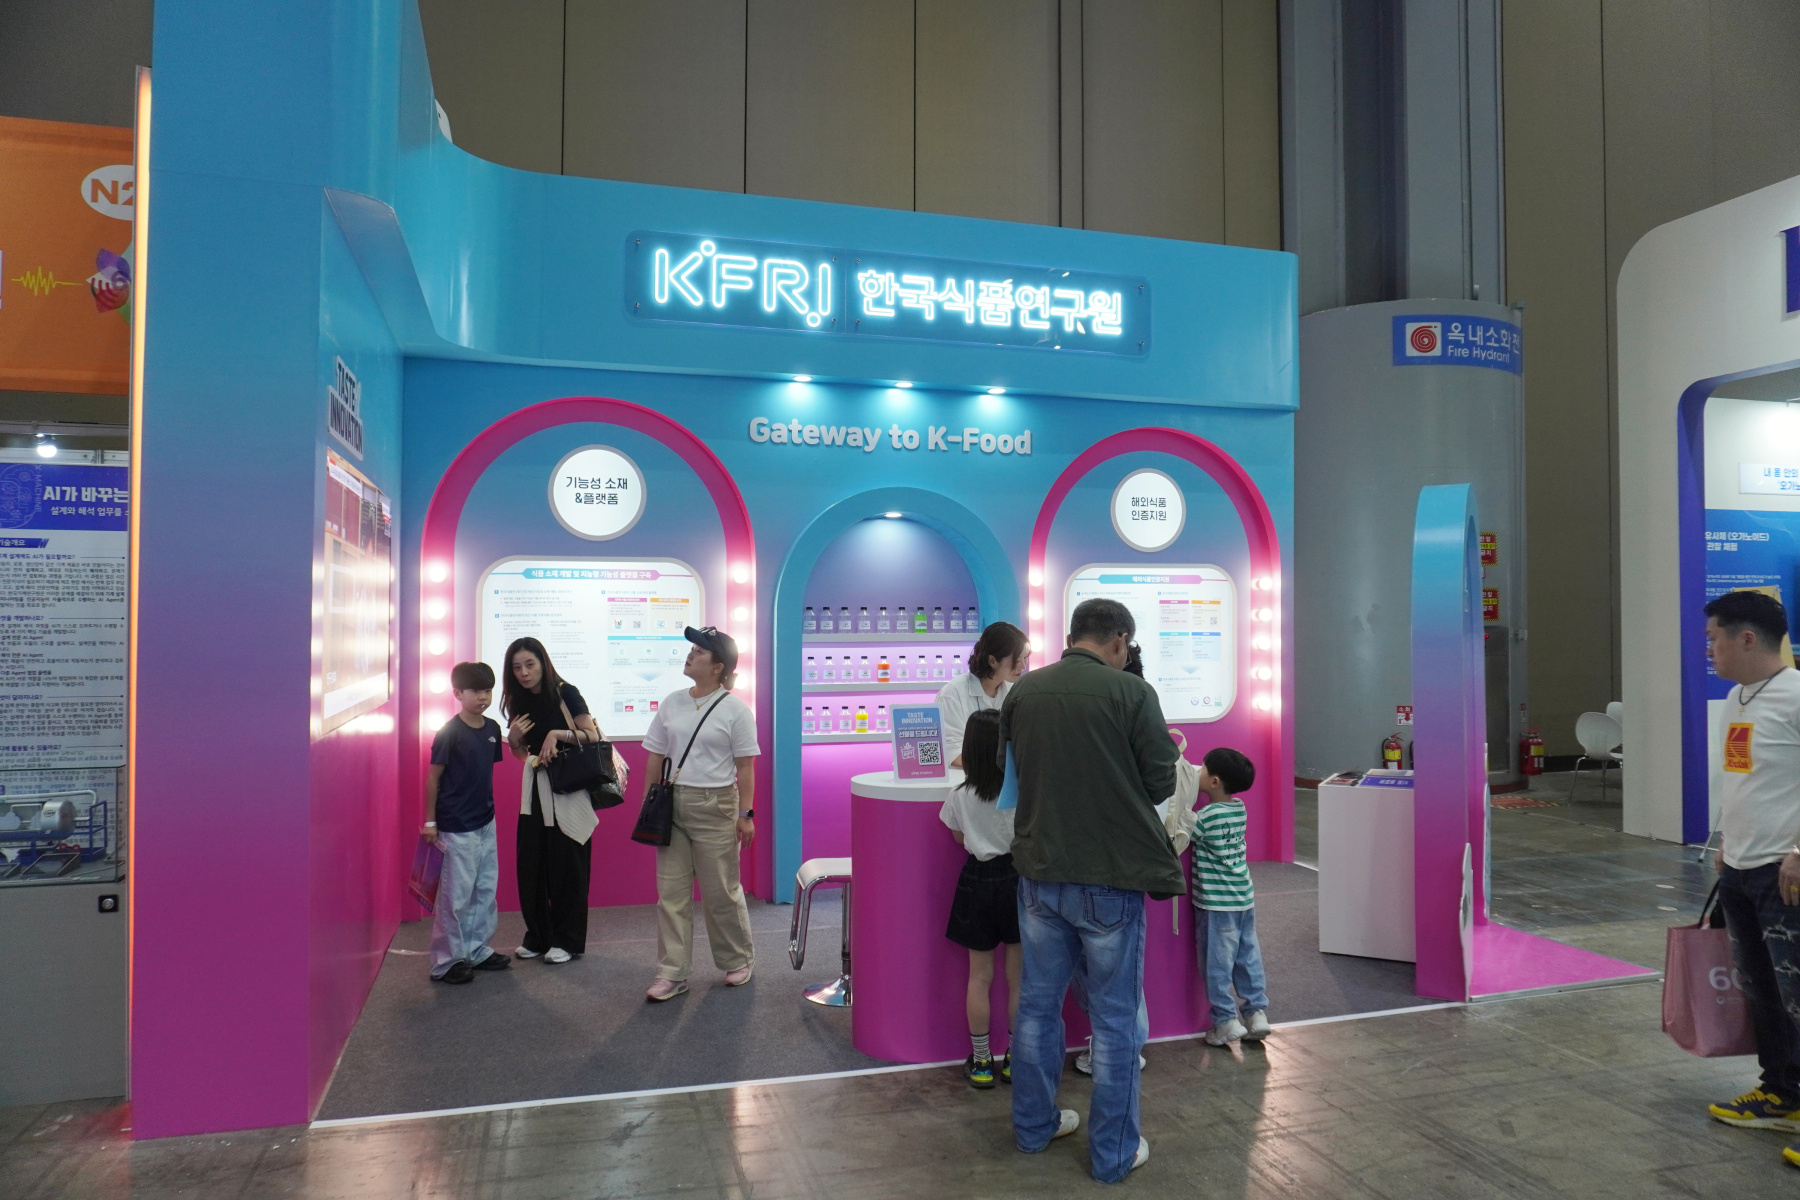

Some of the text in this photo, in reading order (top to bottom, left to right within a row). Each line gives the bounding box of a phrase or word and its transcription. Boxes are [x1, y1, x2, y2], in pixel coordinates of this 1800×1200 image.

[653, 239, 832, 328] KFRI
[857, 269, 1123, 336] 한국식품연구원
[1447, 322, 1520, 354] 옥내소화전
[1448, 345, 1510, 363] Fire Hydrant
[337, 361, 356, 413] TASTE
[330, 391, 363, 456] INNOVATION
[749, 416, 1032, 456] Gateway to K-Food
[566, 476, 628, 490] 기능성 소재
[43, 486, 128, 503] AI가 바꾸는
[575, 492, 619, 505] &플랫폼
[1131, 496, 1167, 508] 해외식품
[50, 506, 122, 517] 설계와 해석 업무를
[1131, 510, 1167, 521] 인증지원
